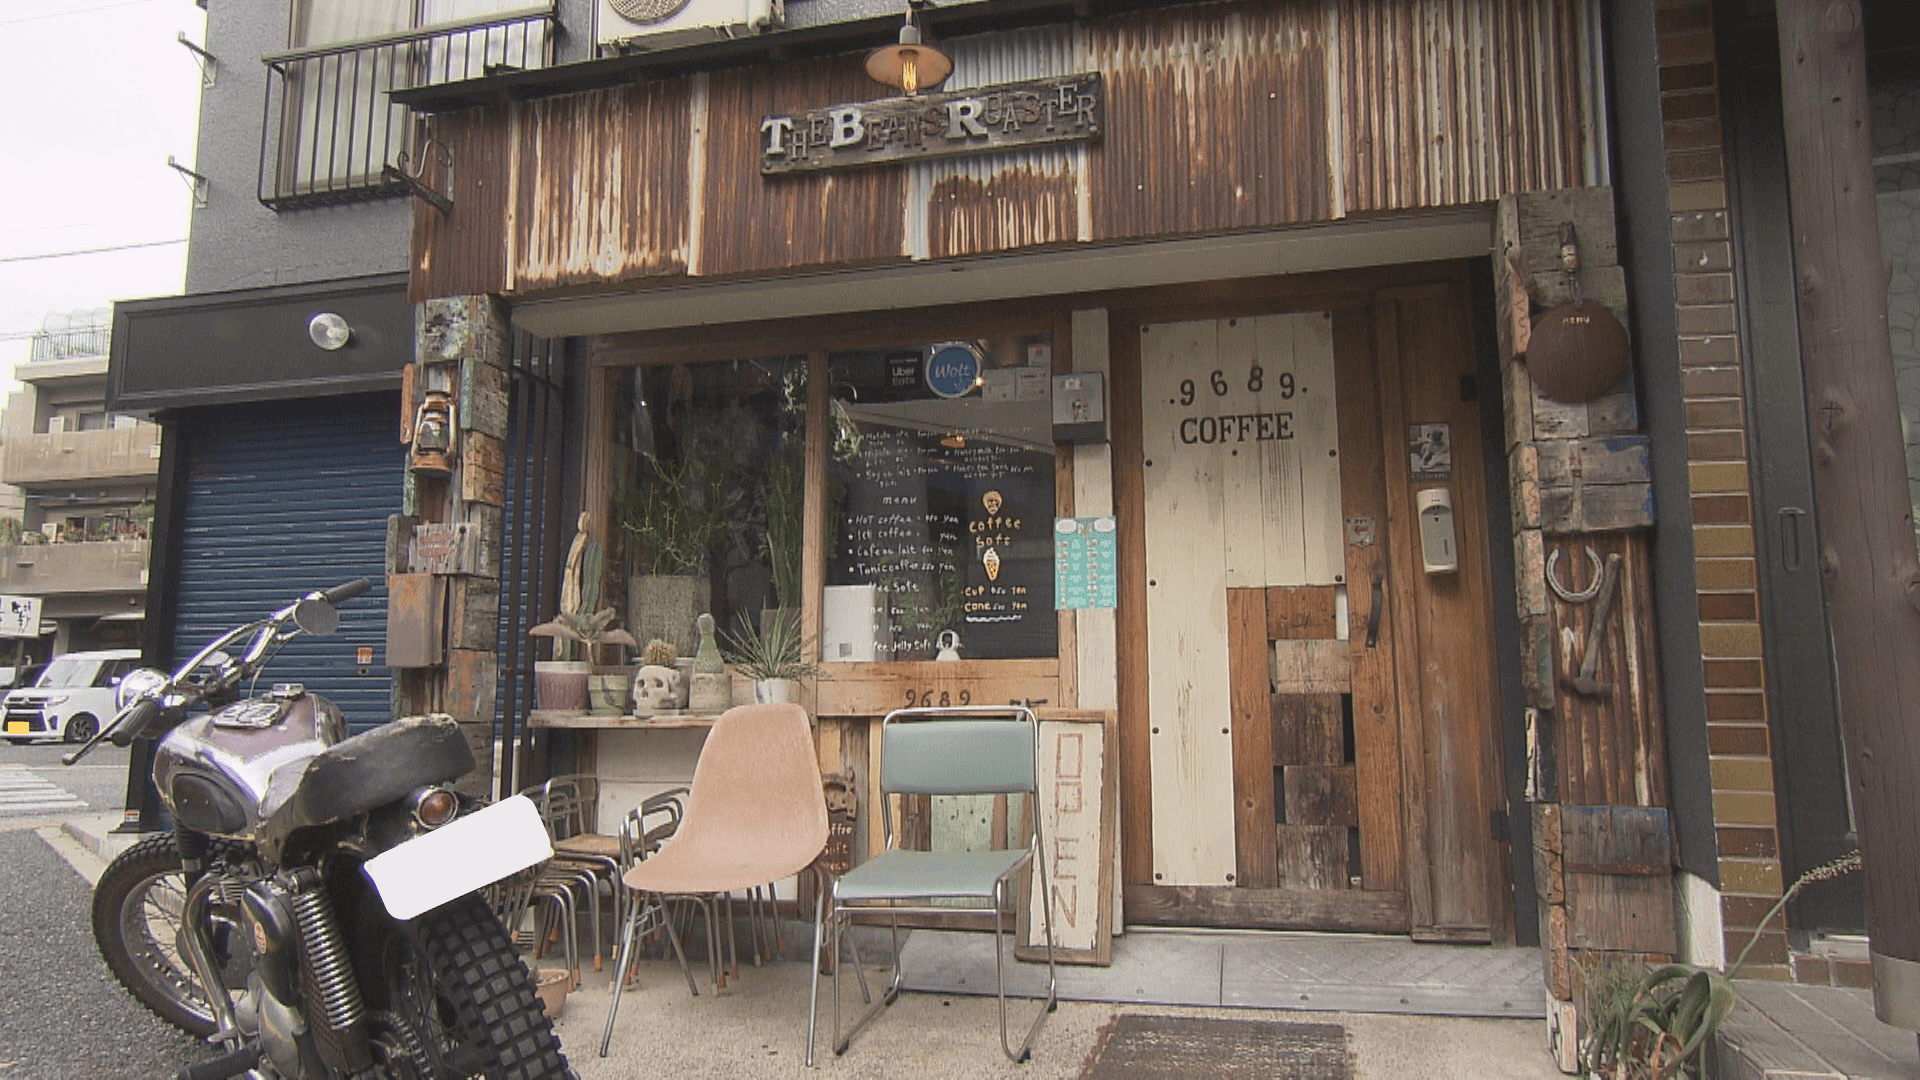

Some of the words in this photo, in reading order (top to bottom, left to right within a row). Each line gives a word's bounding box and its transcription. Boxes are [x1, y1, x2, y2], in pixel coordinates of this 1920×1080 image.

[935, 363, 970, 378] Wolt
[1179, 412, 1294, 444] COFFEE
[905, 688, 971, 709] 9689
[1051, 732, 1084, 929] OPEN
